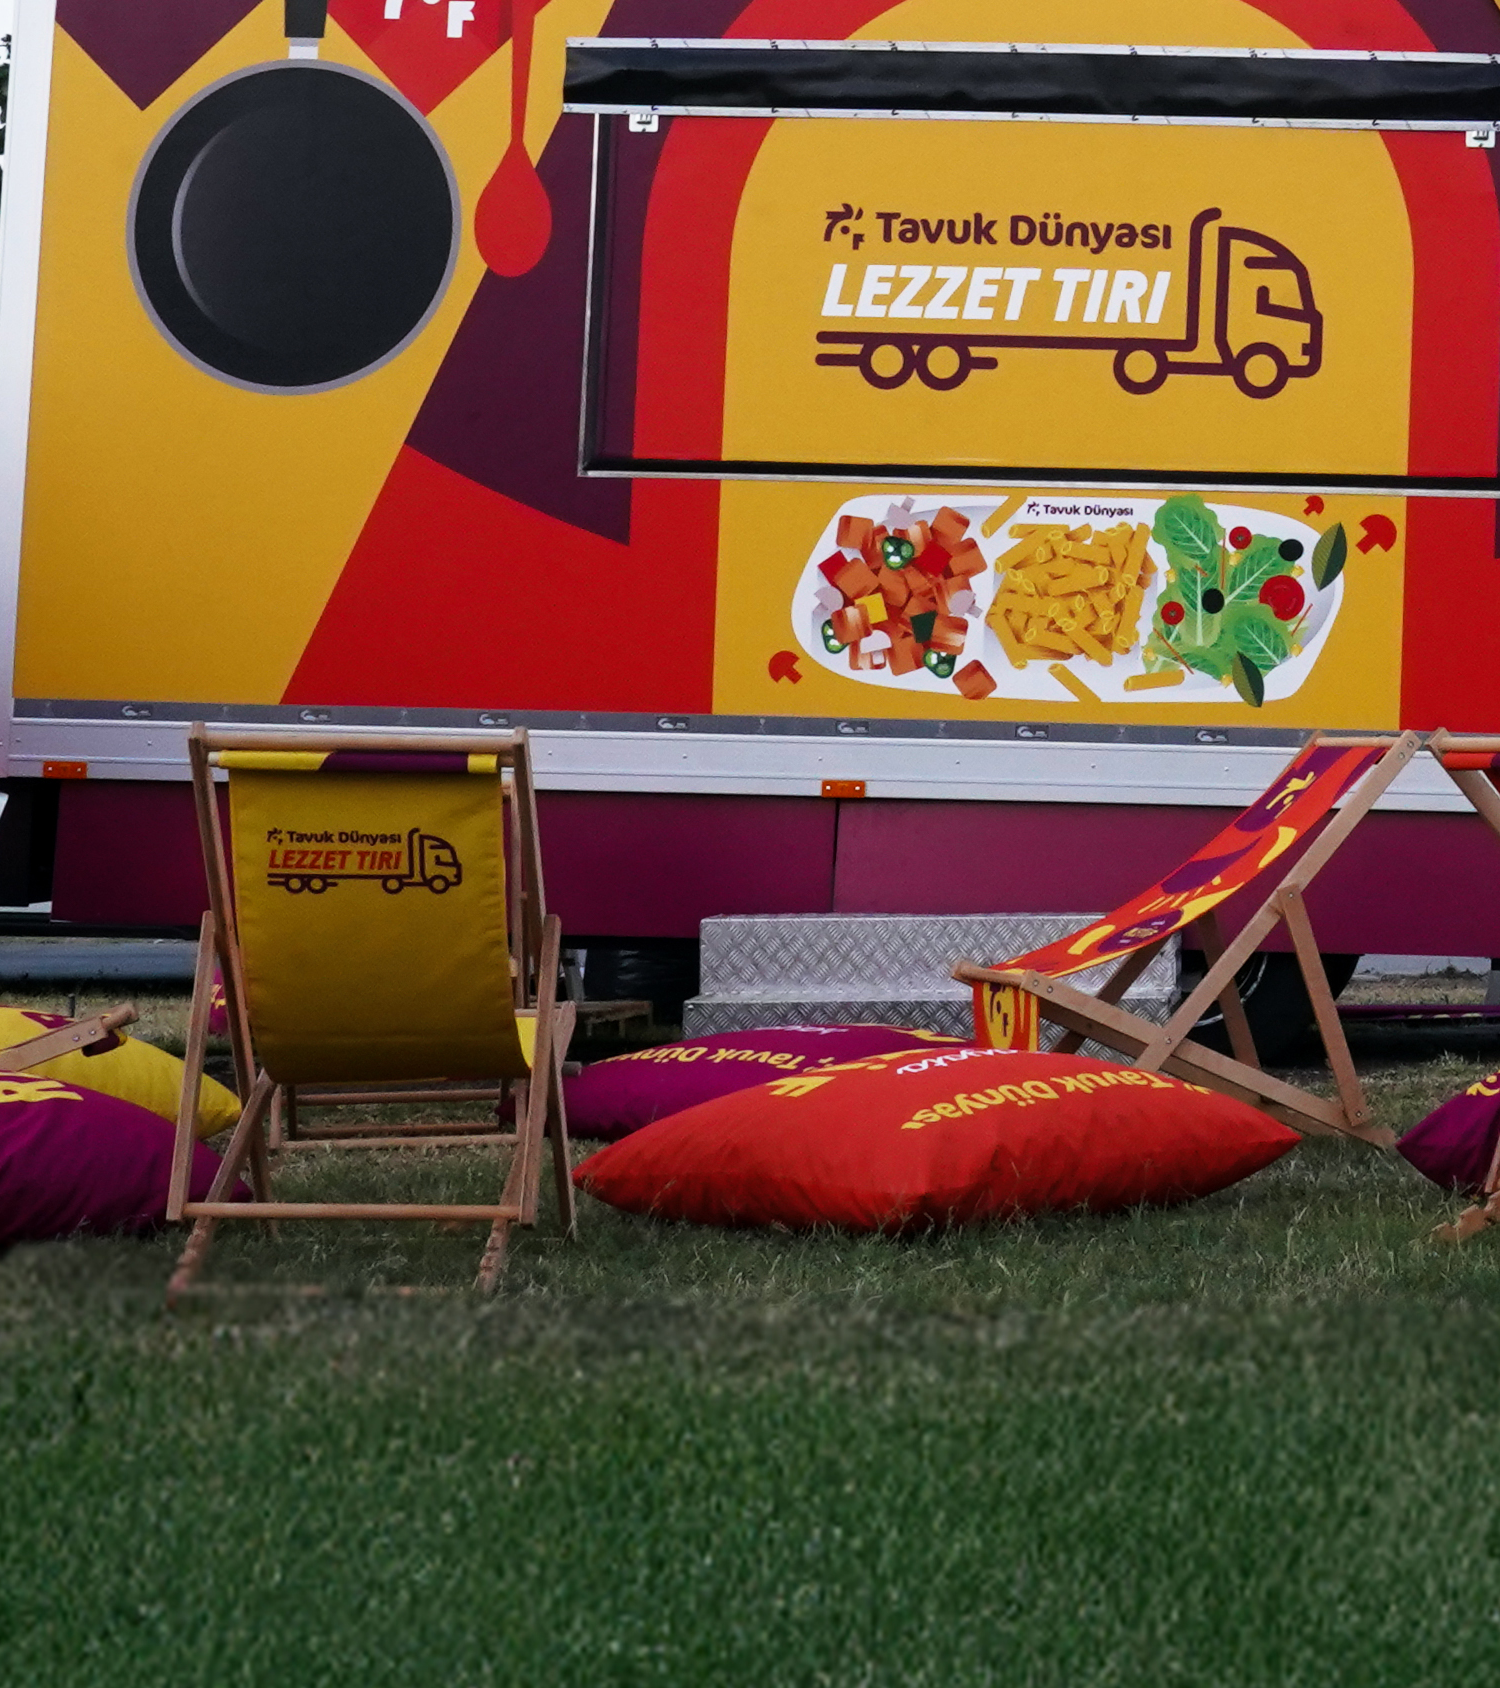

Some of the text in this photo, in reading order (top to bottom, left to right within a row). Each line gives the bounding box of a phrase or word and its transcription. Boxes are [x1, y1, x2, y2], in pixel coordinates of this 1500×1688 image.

[875, 211, 1173, 254] Tavuk Dünyası
[820, 262, 1172, 325] LEZZET TIRI
[1043, 504, 1134, 518] Tavuk Dünyası
[287, 830, 402, 846] Tavuk Dünyası
[269, 849, 402, 870] LEZZET TIRI
[706, 1049, 806, 1070] Tavuk
[900, 1069, 1175, 1130] Tavuk Dünyası
